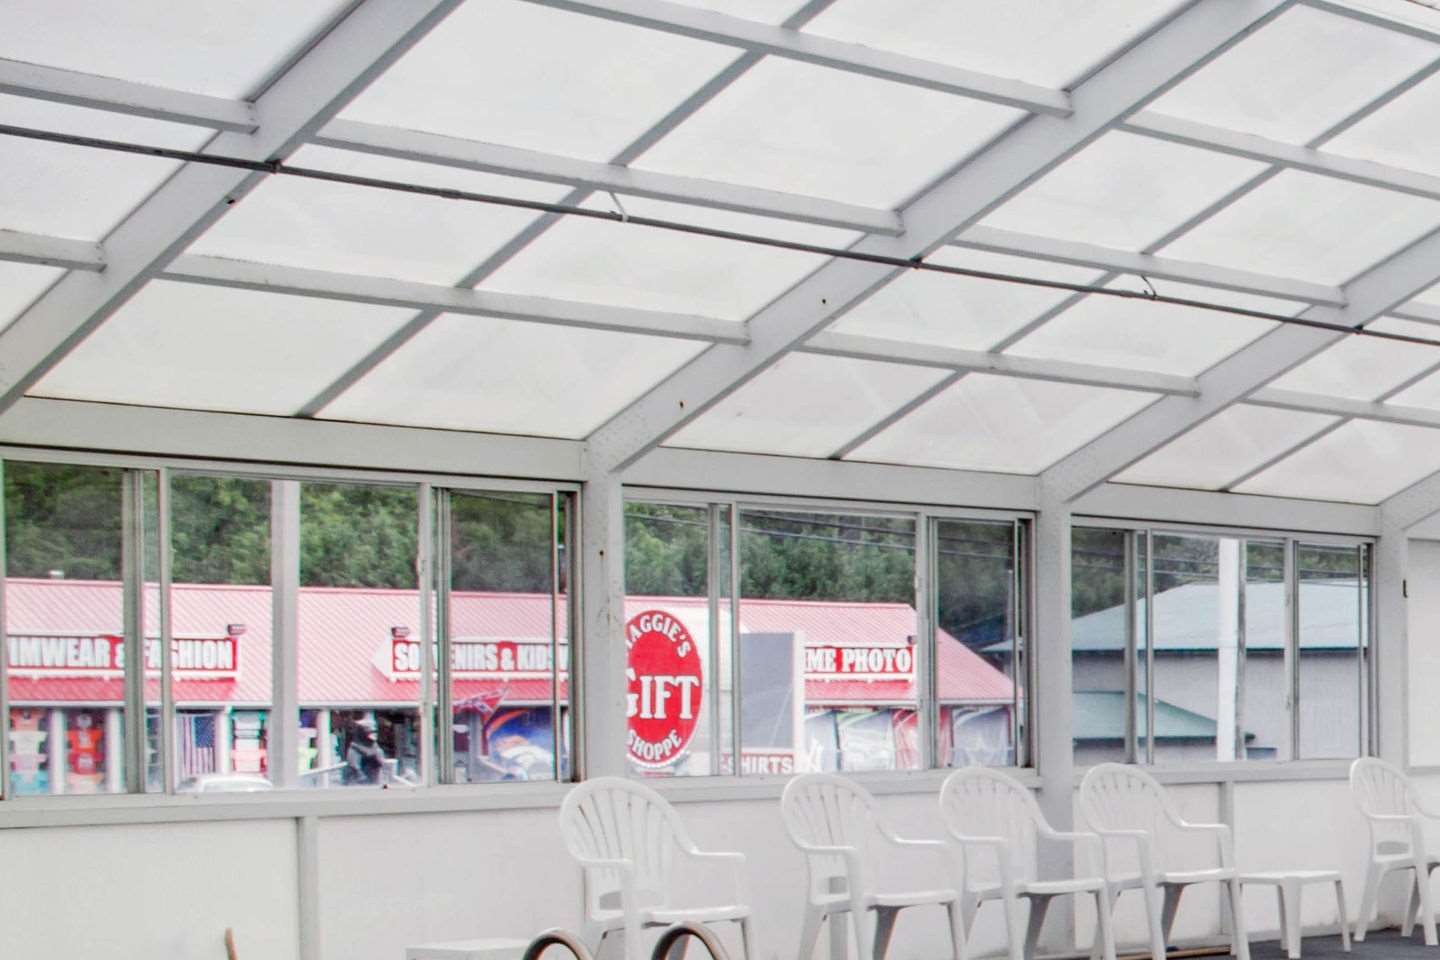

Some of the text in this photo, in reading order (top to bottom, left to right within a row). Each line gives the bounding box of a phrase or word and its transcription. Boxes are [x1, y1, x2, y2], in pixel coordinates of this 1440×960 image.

[500, 648, 515, 671] &
[841, 648, 912, 673] PHOTO
[626, 667, 700, 720] GIFT
